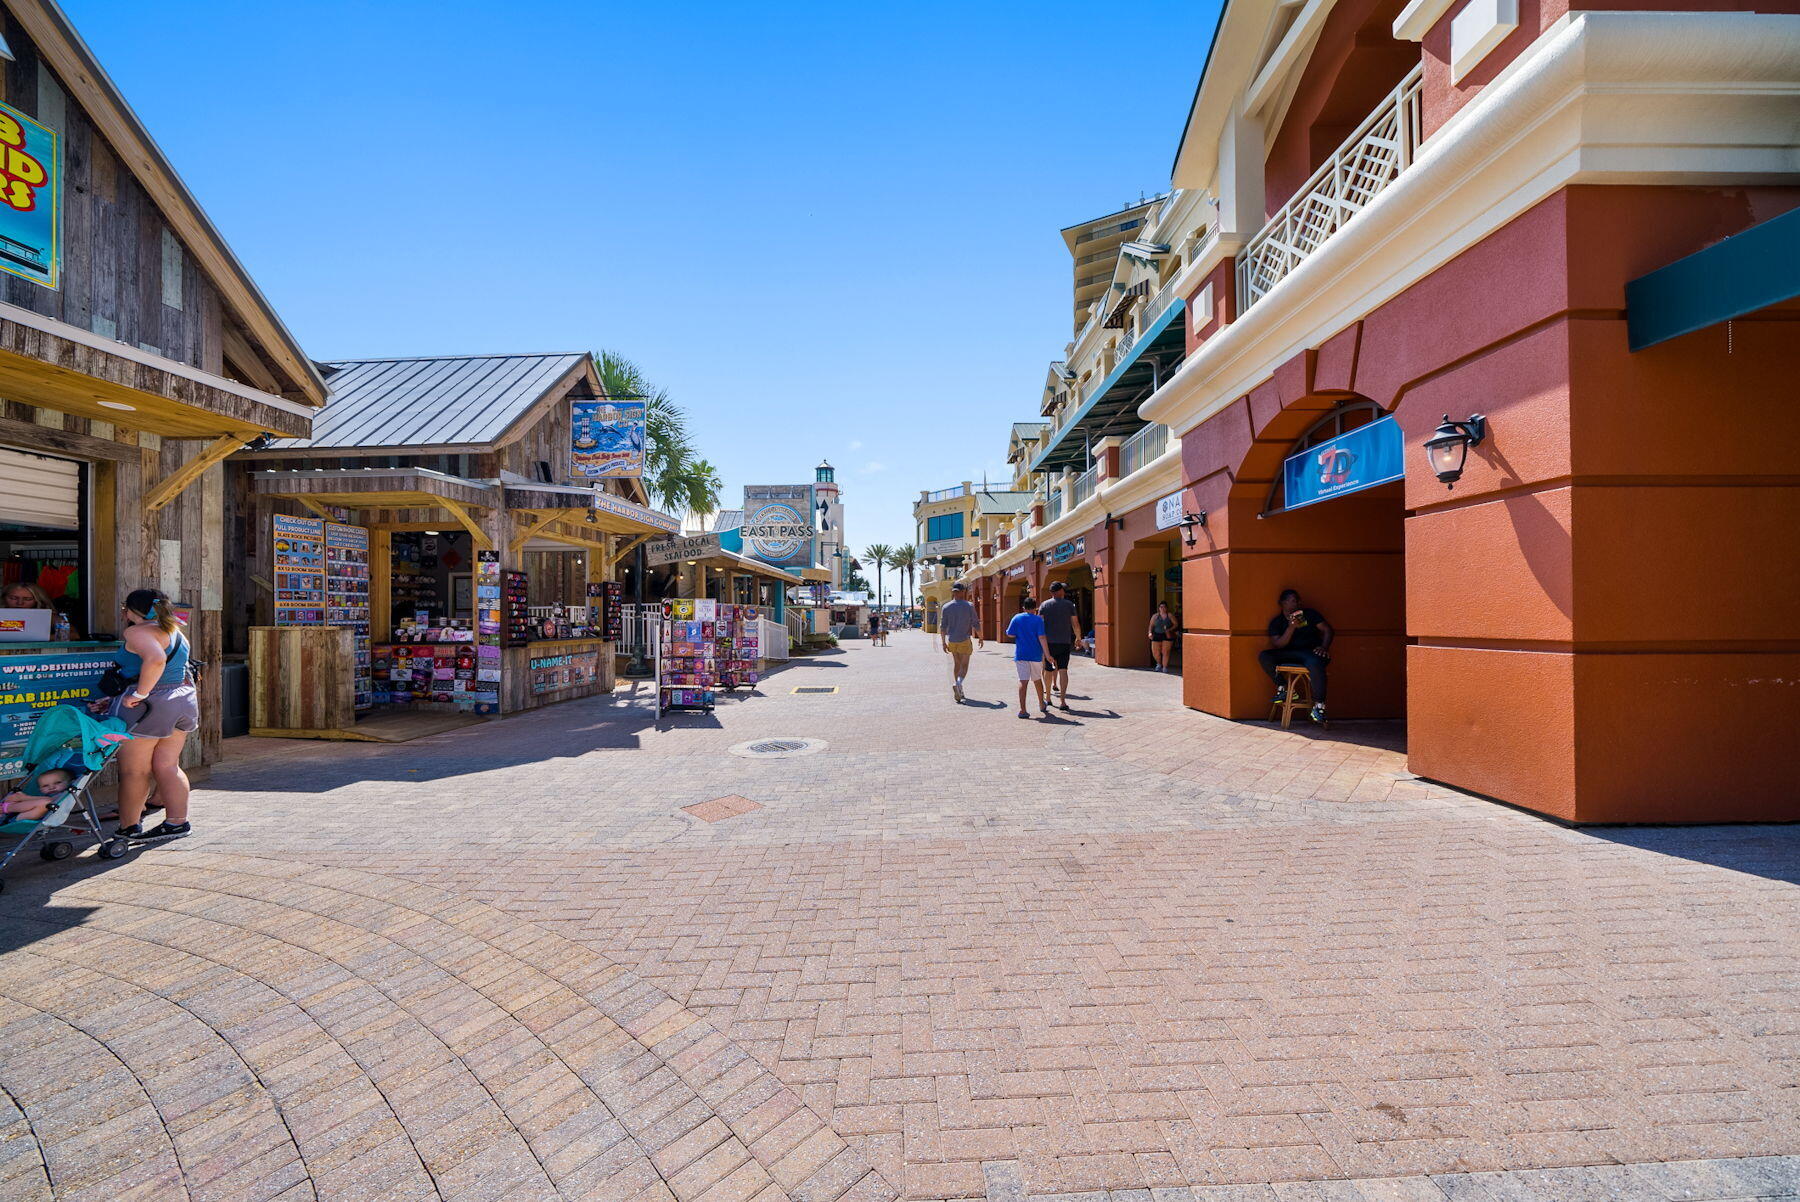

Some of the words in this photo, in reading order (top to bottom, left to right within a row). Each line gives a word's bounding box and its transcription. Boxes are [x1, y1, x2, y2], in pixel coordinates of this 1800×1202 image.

[1317, 486, 1334, 495] Virtual
[1333, 479, 1360, 491] Experience
[596, 498, 611, 510] THE
[613, 504, 639, 519] HARBOR
[640, 513, 654, 524] SIGN
[656, 519, 680, 531] COMPANY
[740, 525, 774, 537] EAST
[780, 525, 814, 537] PASS
[683, 536, 711, 548] LOCAL
[2, 661, 116, 674] WWW.DESTINSNORK
[55, 670, 92, 678] PICTURES
[40, 688, 90, 701] ISLAND
[31, 701, 58, 709] TOUR
